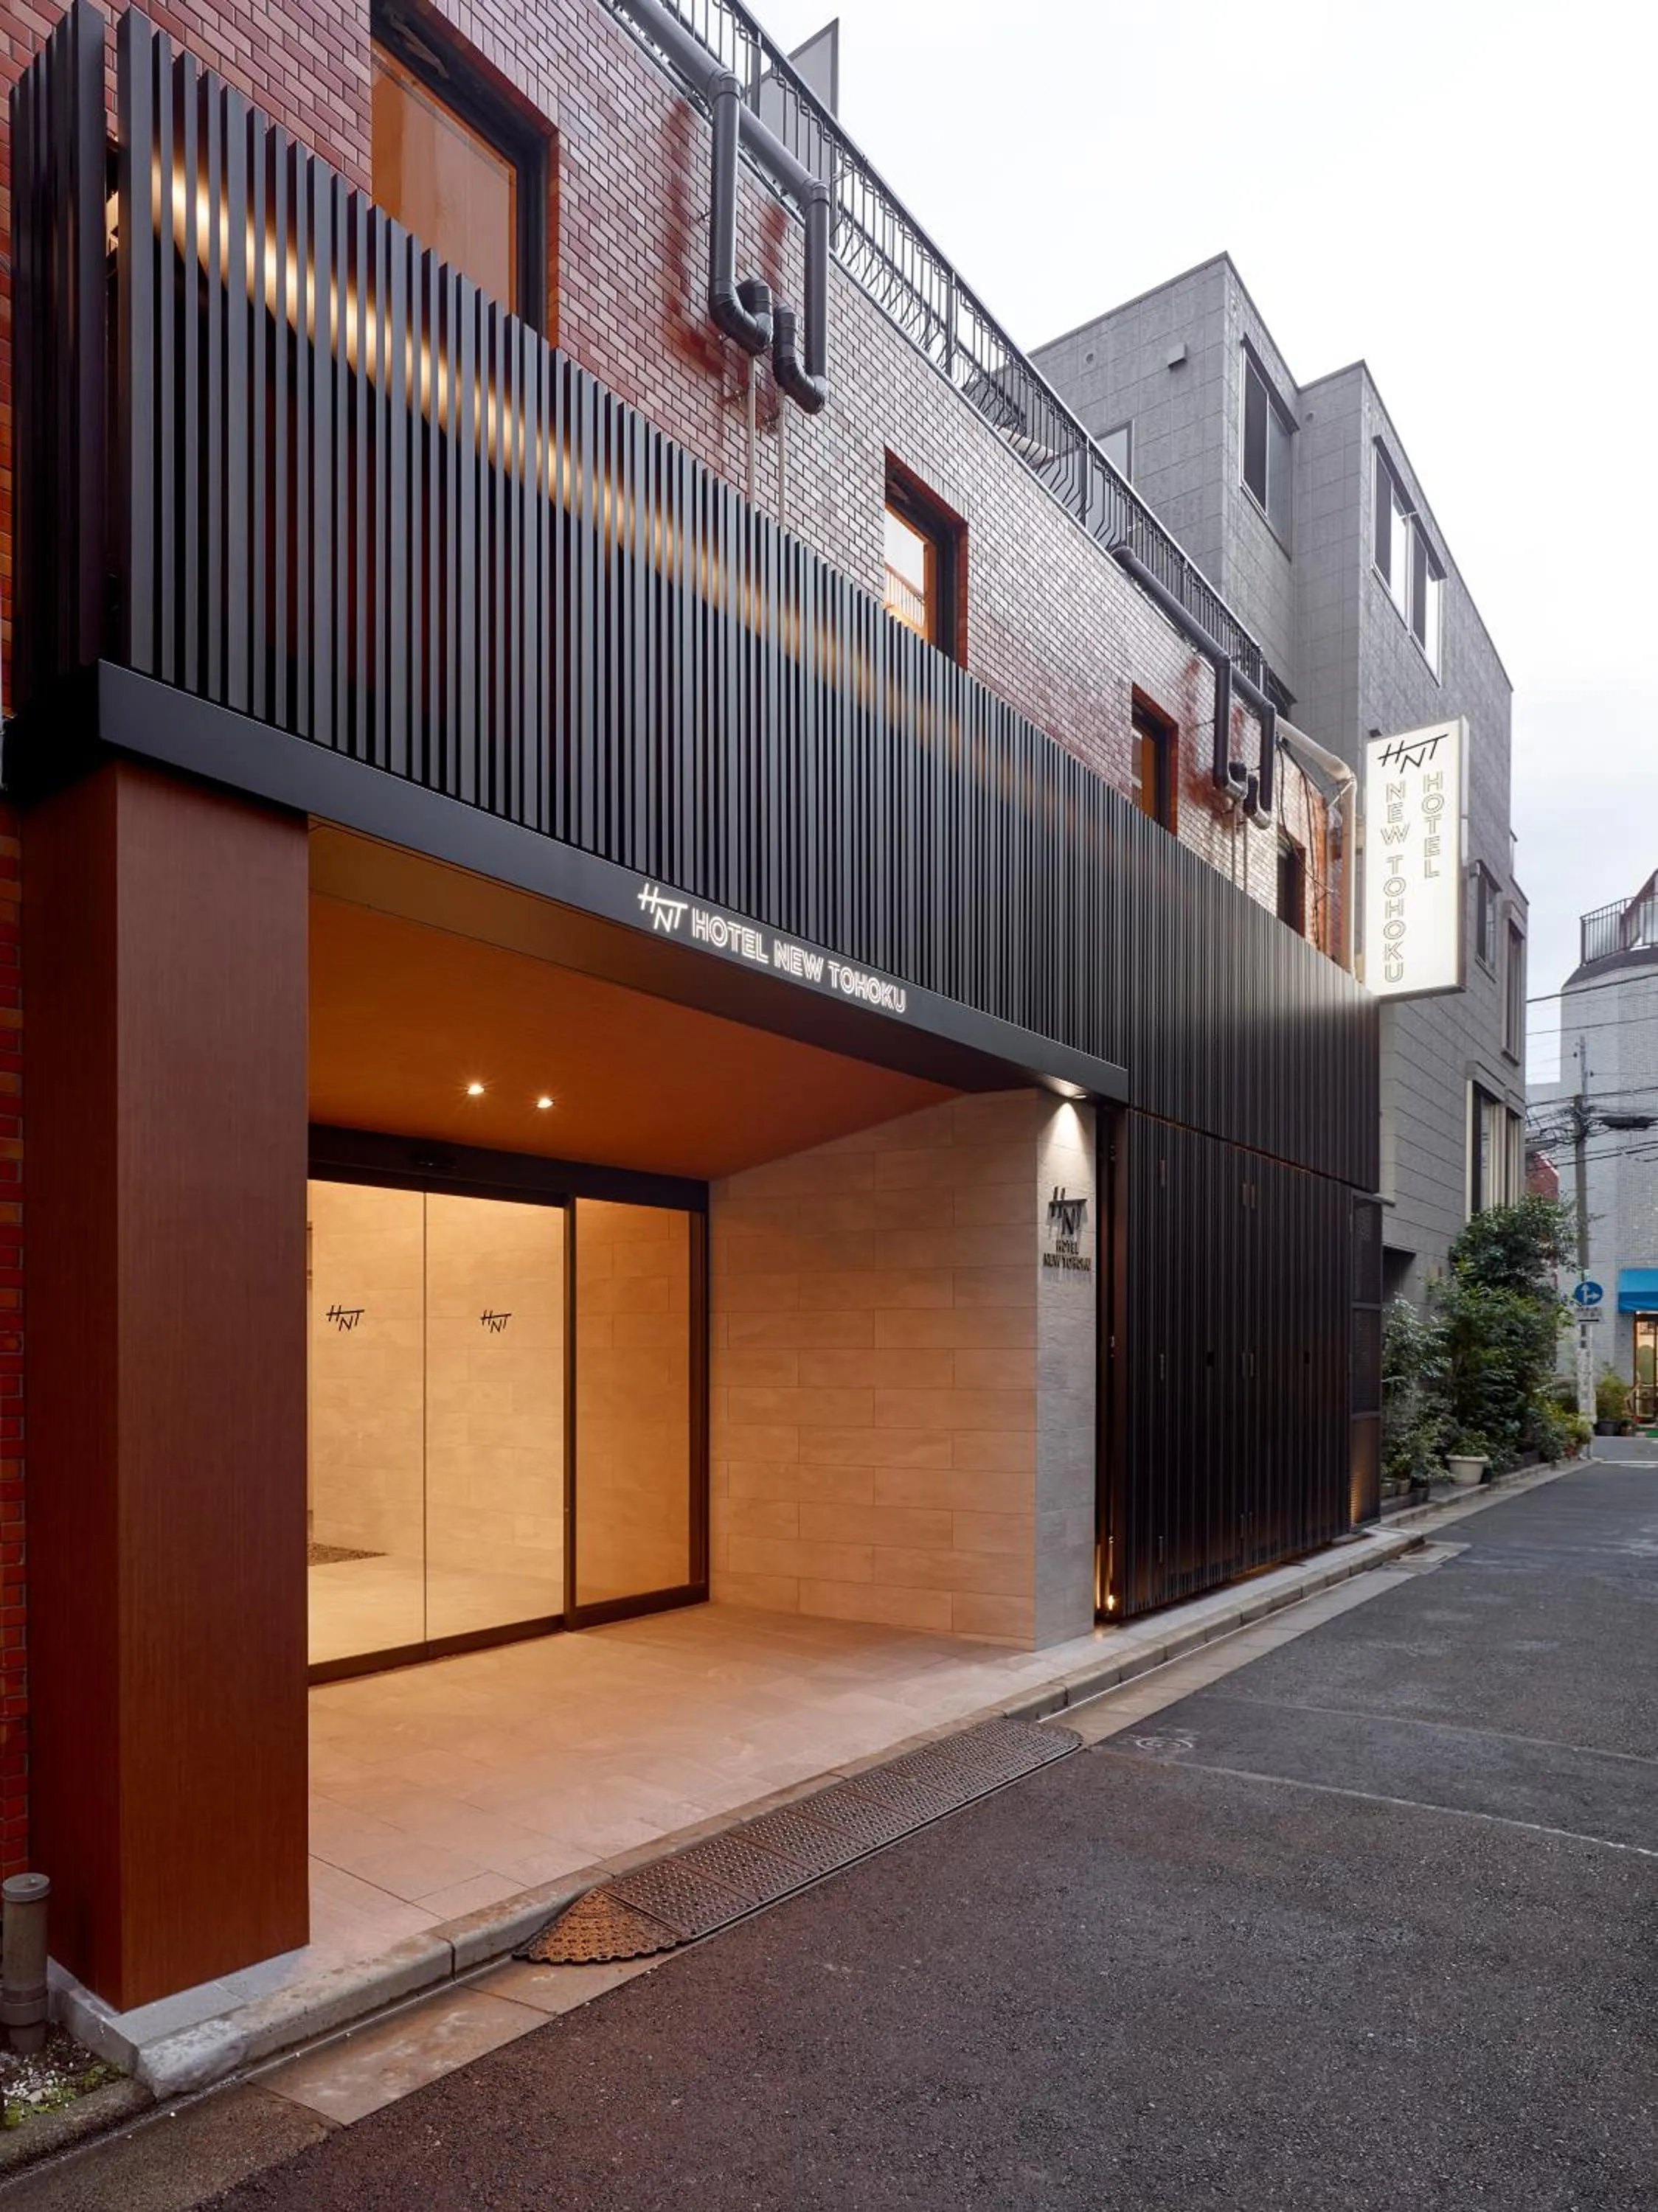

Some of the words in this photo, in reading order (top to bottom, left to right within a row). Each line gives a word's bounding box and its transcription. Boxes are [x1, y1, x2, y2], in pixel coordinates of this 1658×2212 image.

[1378, 734, 1449, 773] HNT
[1381, 779, 1411, 846] NEW
[1421, 770, 1445, 878] HOTEL
[637, 883, 687, 933] HNT
[692, 907, 769, 964] HOTEL
[774, 939, 824, 983] NEW
[828, 961, 907, 1014] TOHOKU
[1383, 855, 1406, 983] TOHOKU
[325, 1304, 364, 1332] HNT
[480, 1310, 512, 1333] HNT
